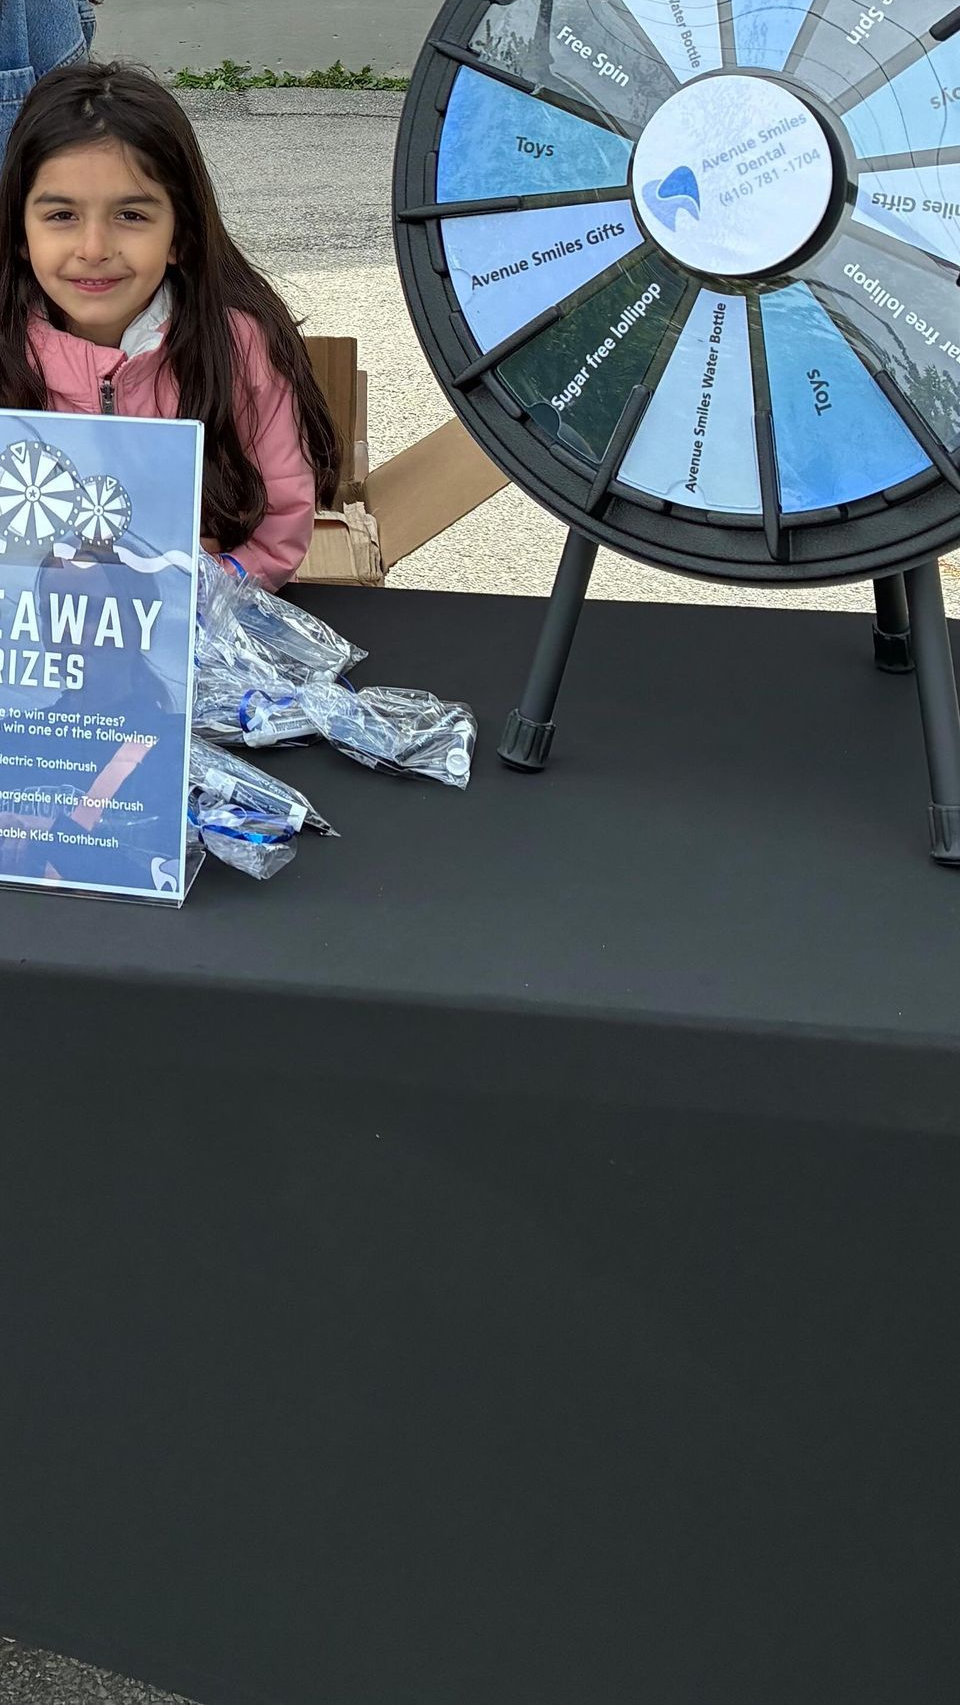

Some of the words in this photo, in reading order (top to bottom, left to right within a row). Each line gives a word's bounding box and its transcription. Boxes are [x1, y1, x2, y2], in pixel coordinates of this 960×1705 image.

[846, 5, 885, 45] Spin
[556, 26, 591, 60] Free
[592, 52, 630, 88] Spin
[681, 30, 701, 69] Bottle
[516, 136, 554, 159] Toys
[701, 137, 756, 173] Avenue
[757, 112, 807, 142] Smiles
[735, 143, 786, 176] Dental
[719, 180, 754, 207] (416)
[757, 169, 782, 190] 781
[871, 192, 916, 213] Gifts
[471, 260, 529, 291] Avenue
[532, 240, 583, 268] Smiles
[586, 221, 625, 245] Gifts
[843, 263, 905, 319] lollipop
[710, 302, 727, 344] Bottle
[905, 311, 940, 345] free
[551, 366, 590, 411] Sugar
[586, 337, 616, 369] free
[610, 282, 661, 339] lollipop
[702, 347, 719, 389] Water
[807, 368, 832, 417] Toys
[694, 392, 712, 437] Smiles
[685, 440, 703, 493] Avenue
[3, 720, 24, 734] win
[29, 725, 52, 736] one
[56, 725, 68, 738] of
[71, 726, 92, 740] the
[95, 729, 158, 747] following:
[9, 707, 21, 718] to
[24, 708, 44, 720] win
[48, 711, 80, 724] great
[83, 713, 125, 727] prizes?
[35, 757, 97, 773] Toothbrush
[54, 792, 79, 806] Kids
[81, 795, 144, 812] Toothbrush
[30, 829, 54, 842] Kids
[57, 832, 119, 848] Toothbrush
